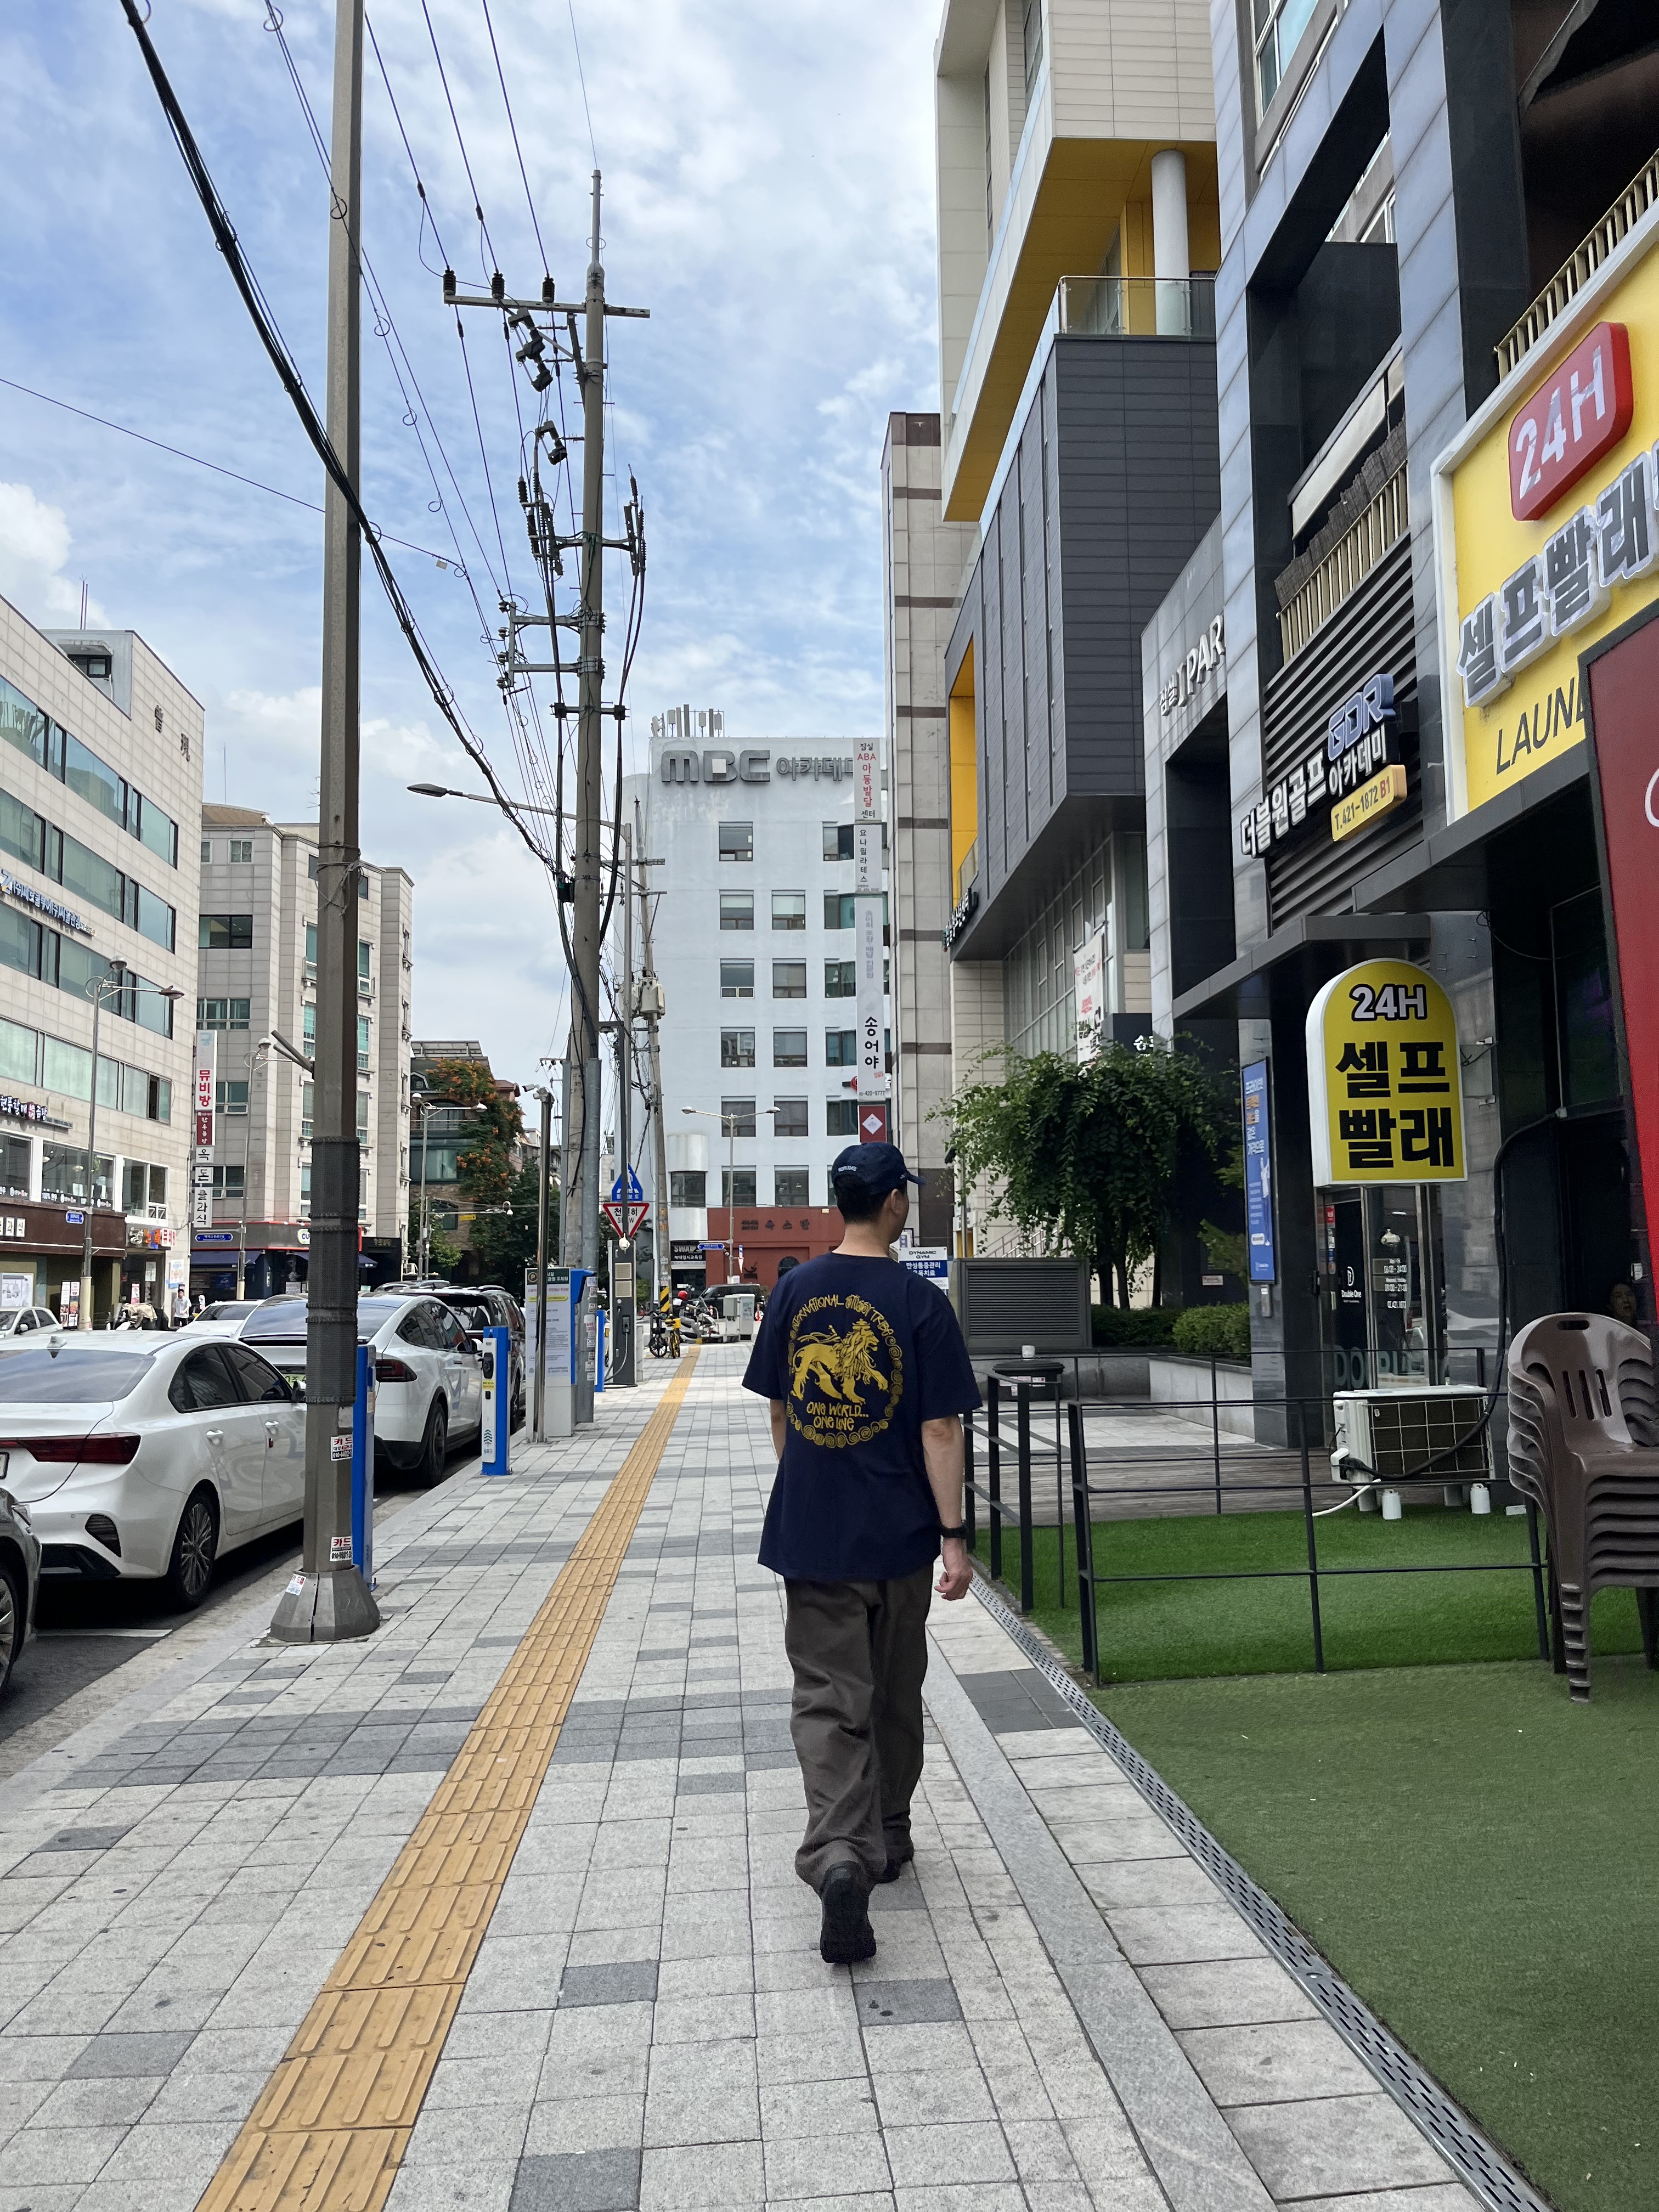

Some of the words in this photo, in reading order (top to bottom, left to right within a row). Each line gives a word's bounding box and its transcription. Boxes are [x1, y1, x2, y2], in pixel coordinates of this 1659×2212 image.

[1515, 345, 1605, 499] 24H
[1458, 440, 1659, 707] 셀프빨래
[1160, 674, 1178, 716] 잠실
[1177, 615, 1225, 707] IPAR
[1328, 674, 1393, 760] GDR
[661, 750, 770, 782] MBC
[860, 743, 873, 751] 잠실
[862, 763, 872, 808] 아동발달
[1241, 748, 1325, 858] 더블원골프
[1329, 724, 1386, 796] 아카데미
[1334, 787, 1379, 831] T.421-1872
[1379, 776, 1391, 799] B1
[861, 810, 875, 819] 센터
[1349, 984, 1427, 1021] 24H
[865, 1016, 879, 1069] 송어야
[1335, 1040, 1451, 1100] 셀프
[1339, 1107, 1454, 1170] 빨래
[614, 1207, 637, 1216] 천히
[333, 1538, 351, 1547] 카드
